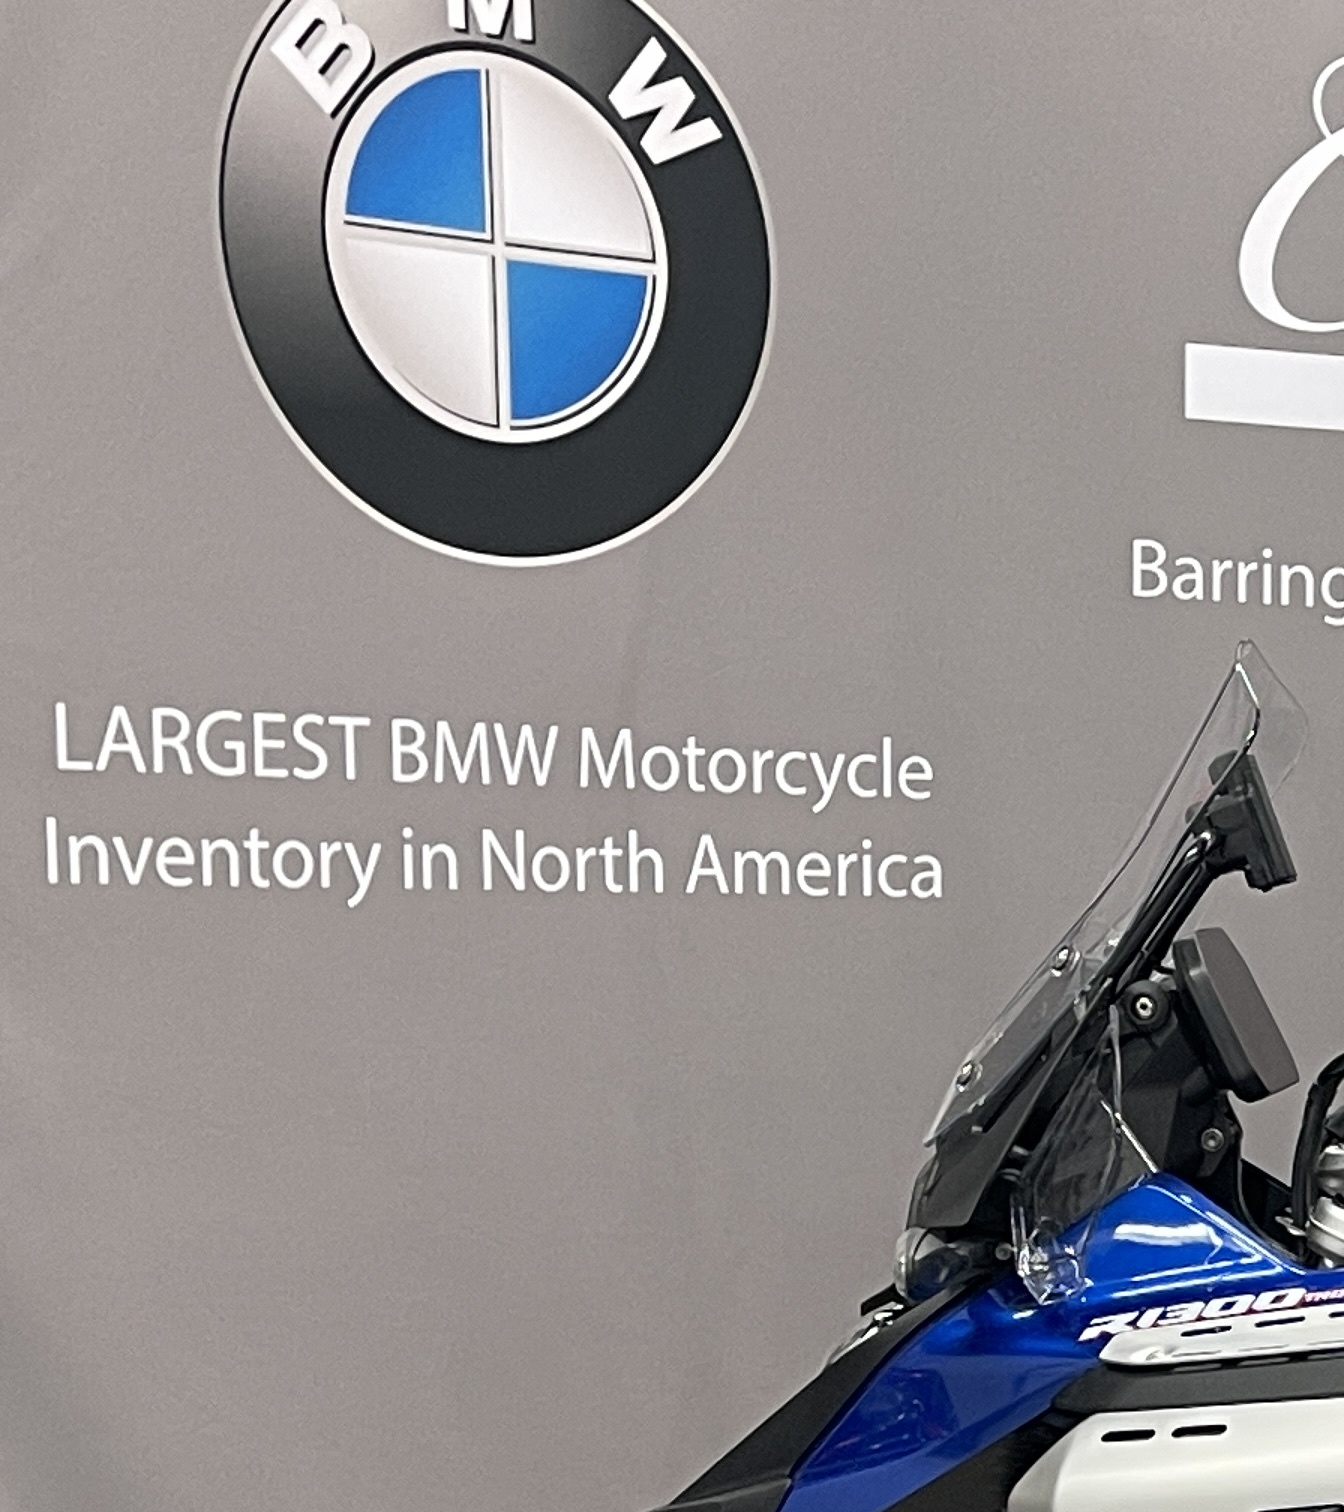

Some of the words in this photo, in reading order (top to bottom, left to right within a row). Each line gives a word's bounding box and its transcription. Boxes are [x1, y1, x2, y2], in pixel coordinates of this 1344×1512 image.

[55, 701, 371, 781] LARGEST
[391, 718, 559, 787] BMW
[579, 727, 934, 814] Motorcycle
[46, 816, 382, 908] Inventory
[402, 826, 458, 890] in
[482, 828, 664, 894] North
[685, 834, 942, 899] America
